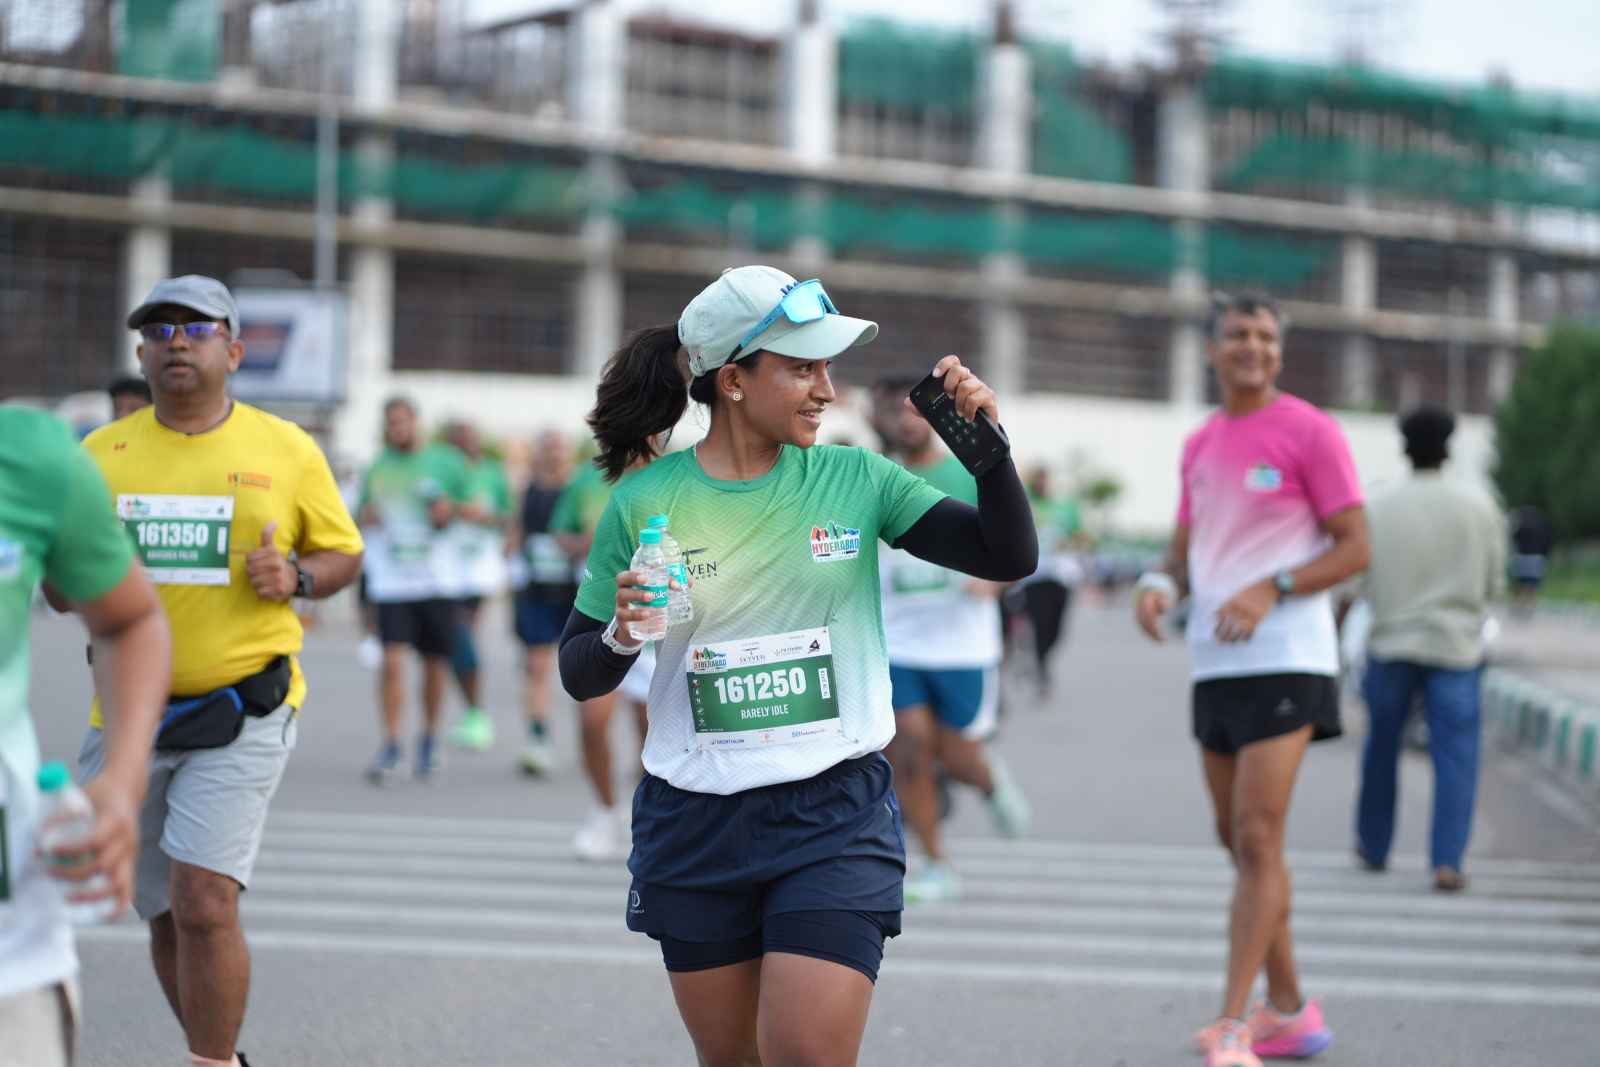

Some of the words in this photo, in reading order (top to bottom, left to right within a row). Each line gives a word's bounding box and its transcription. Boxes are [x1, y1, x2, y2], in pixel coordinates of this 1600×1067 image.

[137, 522, 209, 547] 161350
[812, 538, 860, 554] HYDERABAD
[688, 561, 717, 576] VEN
[714, 667, 807, 705] 161250
[741, 705, 770, 720] RARELY
[771, 704, 790, 715] IDLE
